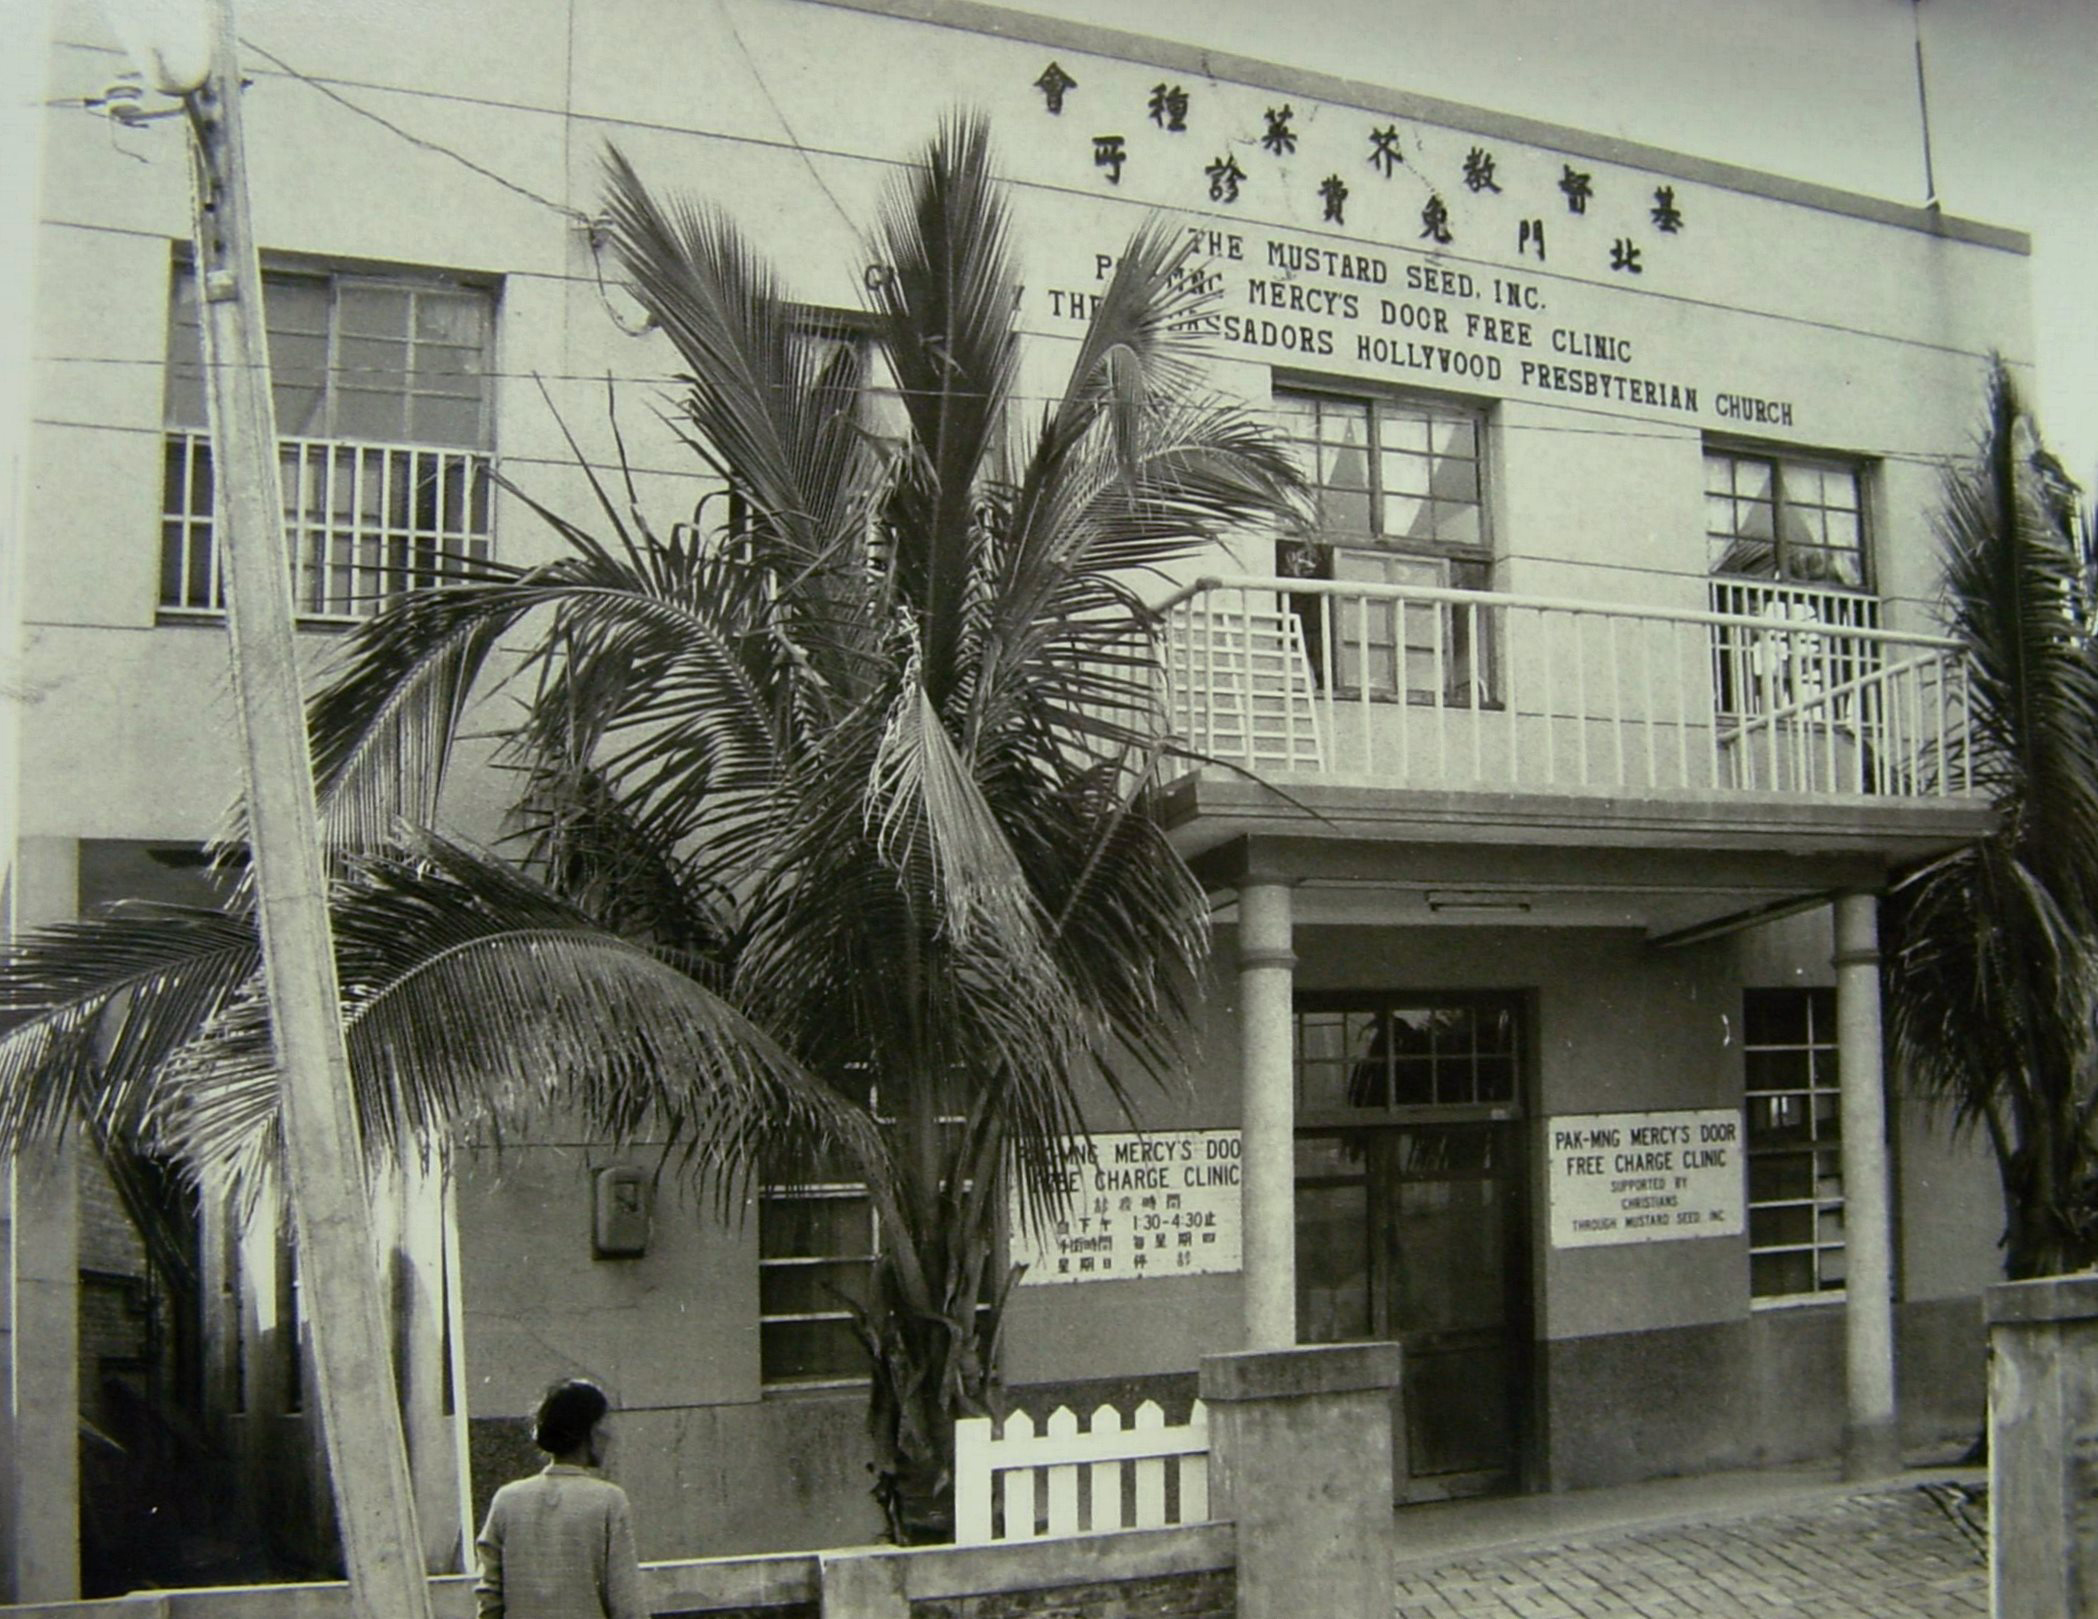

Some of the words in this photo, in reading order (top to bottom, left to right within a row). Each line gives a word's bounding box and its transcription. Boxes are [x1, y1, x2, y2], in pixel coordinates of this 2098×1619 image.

[1187, 227, 1244, 261] THE
[1266, 240, 1388, 285] MUSTARD
[1493, 279, 1547, 311] INC.
[1248, 278, 1360, 320] MERCY'S
[1380, 299, 1449, 334] DOOR
[1467, 313, 1533, 348] FREE
[1551, 328, 1632, 364] CLINIC
[1356, 334, 1502, 381] HOLLYWOOD
[1520, 361, 1699, 413] PRESBYTERIAN
[1715, 393, 1795, 427] CHURCH
[1555, 1129, 1621, 1150] PAK-MNG
[1630, 1125, 1691, 1146] MERCY'S
[1700, 1123, 1737, 1143] DOOR
[1115, 1140, 1192, 1163] MERCY'S
[1206, 1138, 1241, 1160] DOO
[1566, 1155, 1605, 1176] FREE
[1615, 1151, 1673, 1173] CHARGE
[1682, 1149, 1727, 1169] CLINIC
[1095, 1167, 1170, 1191] CHARGE
[1184, 1164, 1241, 1187] CLINIC
[1610, 1177, 1666, 1193] SUPPORTED
[1674, 1176, 1688, 1189] BY
[1620, 1195, 1679, 1210] CHRISTIANS
[1572, 1217, 1618, 1232] THROUGH
[1625, 1213, 1670, 1228] MUSTARD
[1676, 1211, 1701, 1225] SEED
